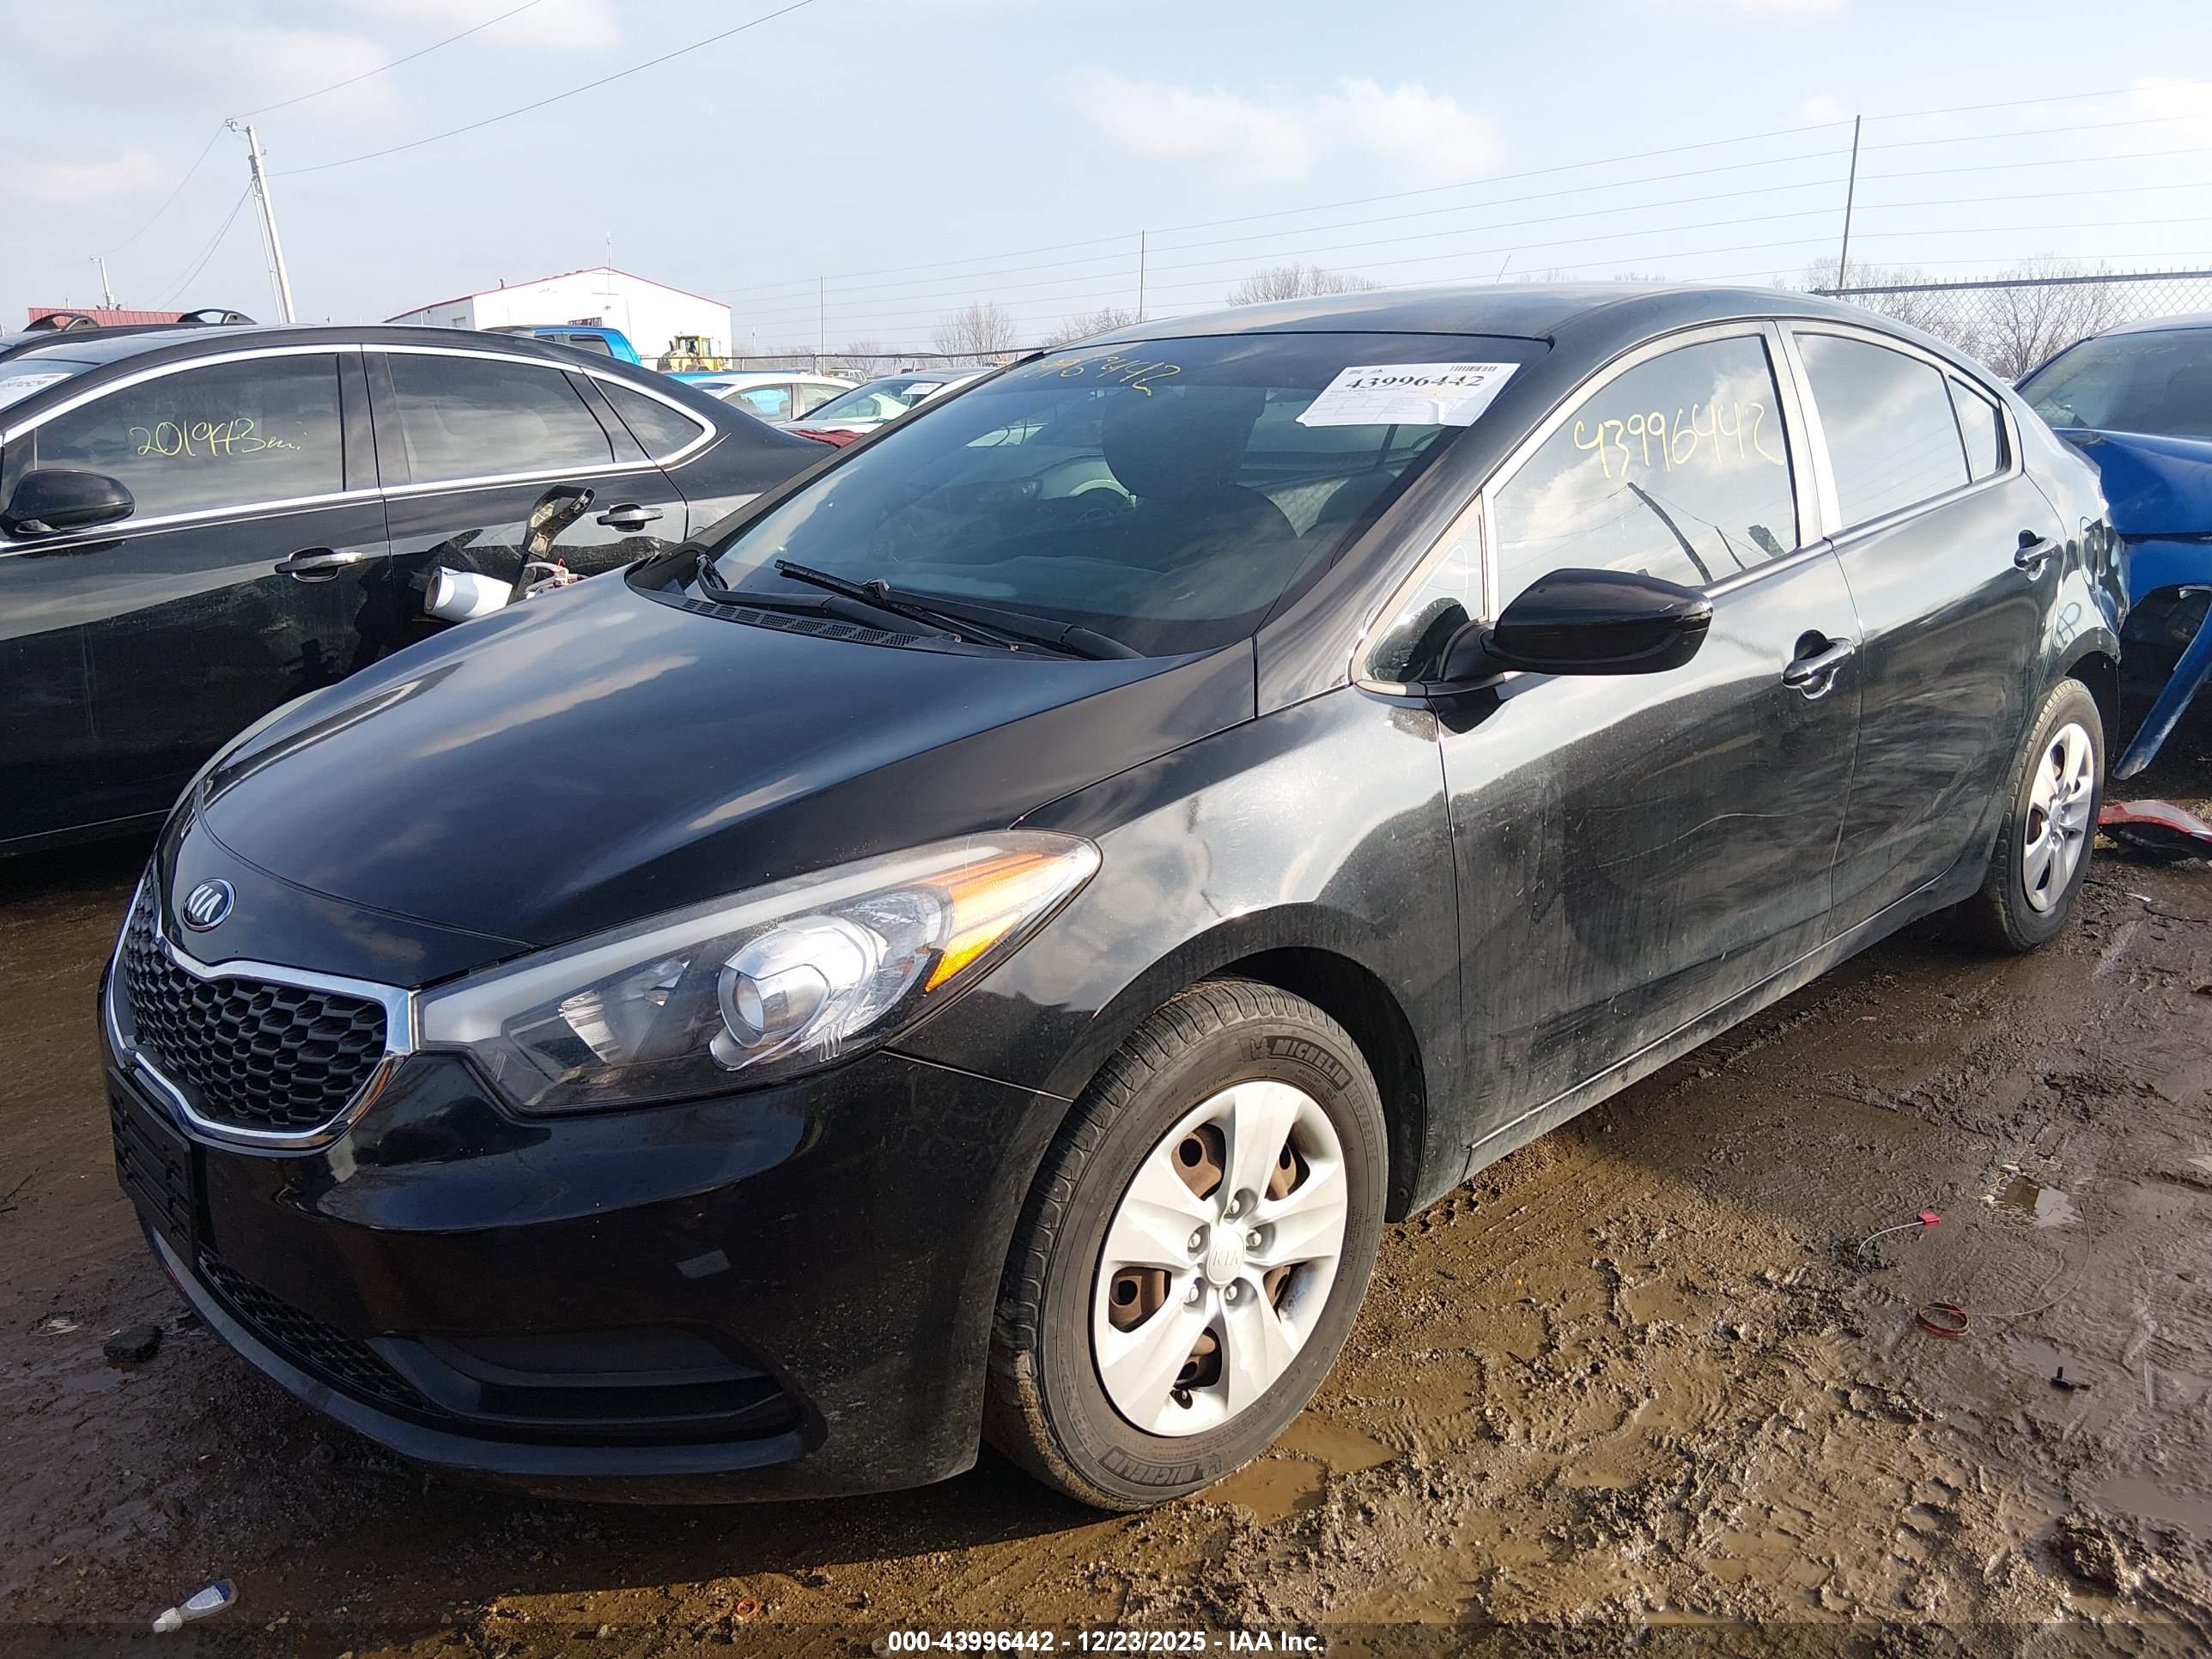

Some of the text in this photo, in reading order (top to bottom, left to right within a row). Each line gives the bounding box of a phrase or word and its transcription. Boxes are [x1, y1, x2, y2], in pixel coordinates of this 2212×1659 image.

[1345, 375, 1485, 389] 43996442
[1573, 399, 1784, 479] 43996442
[1270, 1037, 1352, 1089] MICHELIN
[1212, 1249, 1238, 1266] KIA
[1103, 1450, 1197, 1485] MICHELIN
